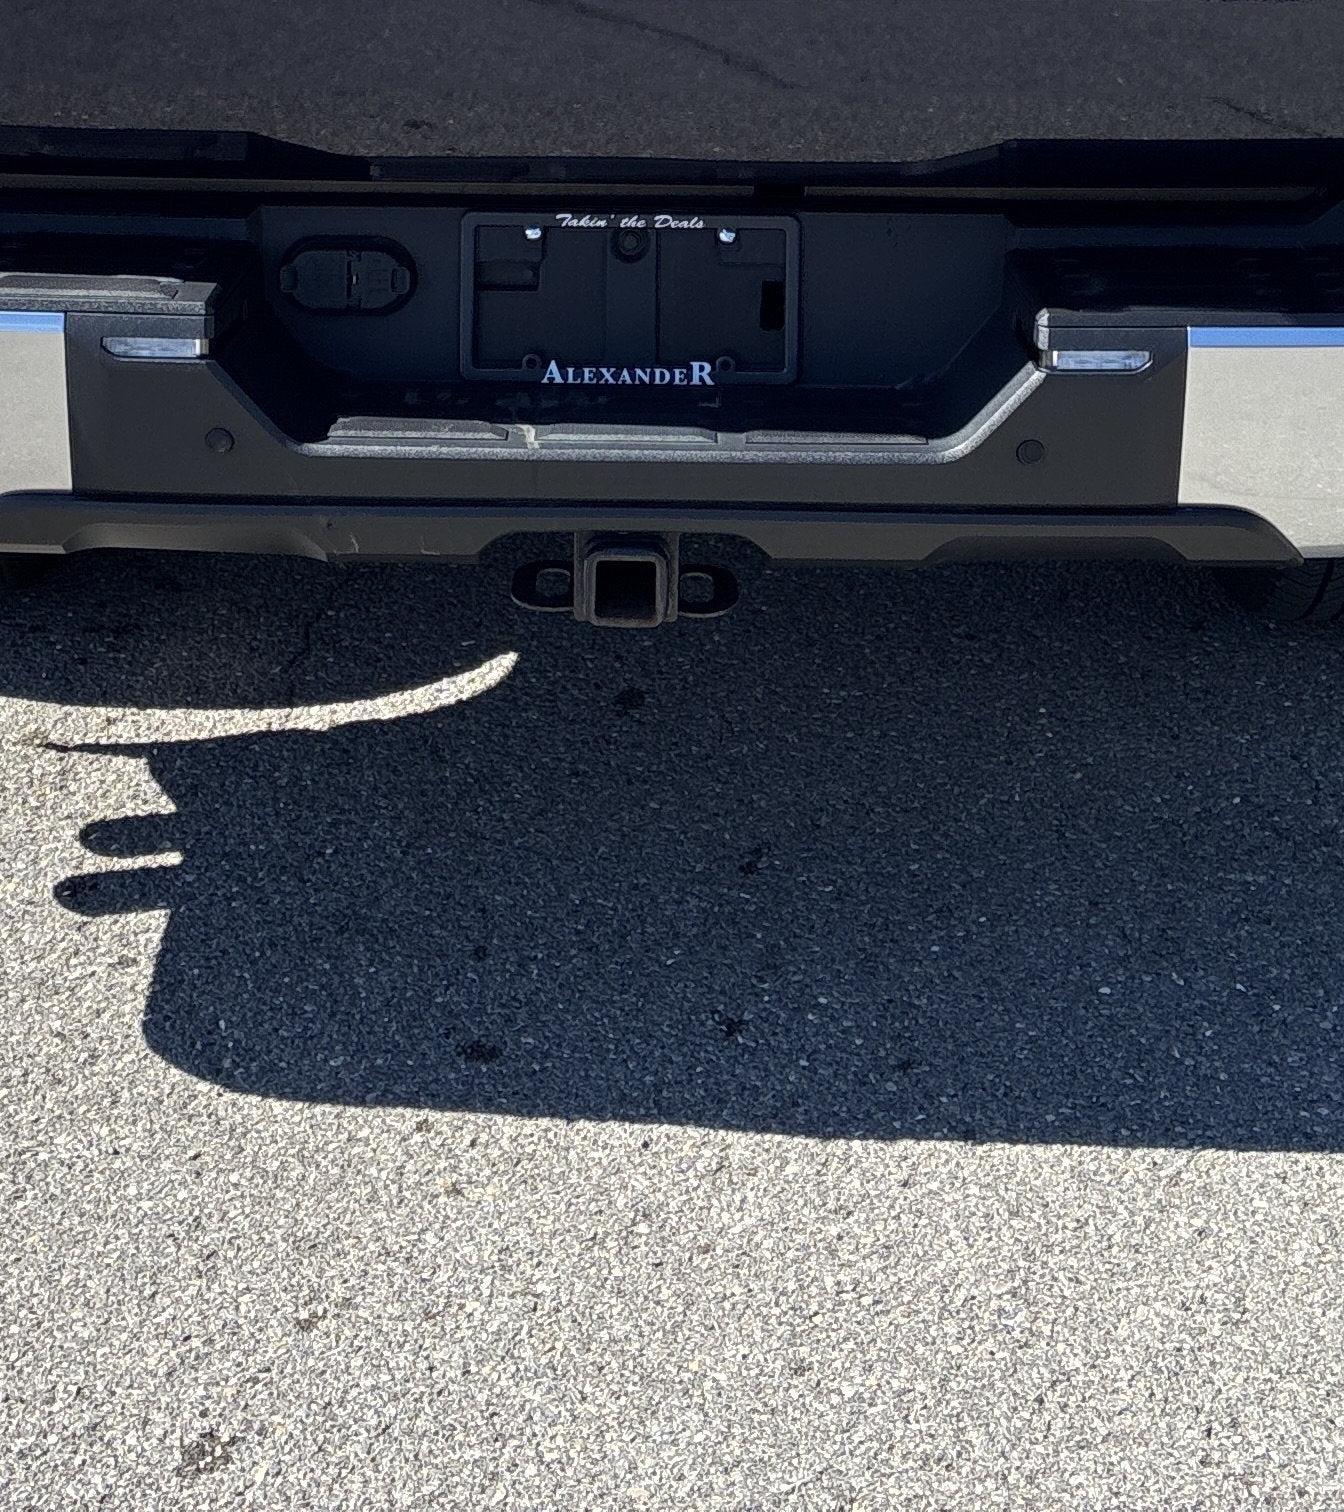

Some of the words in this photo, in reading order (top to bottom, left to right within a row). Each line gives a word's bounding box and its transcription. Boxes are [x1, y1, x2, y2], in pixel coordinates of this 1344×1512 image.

[555, 213, 616, 229] Takin'
[619, 214, 647, 229] the
[654, 215, 706, 230] Deals
